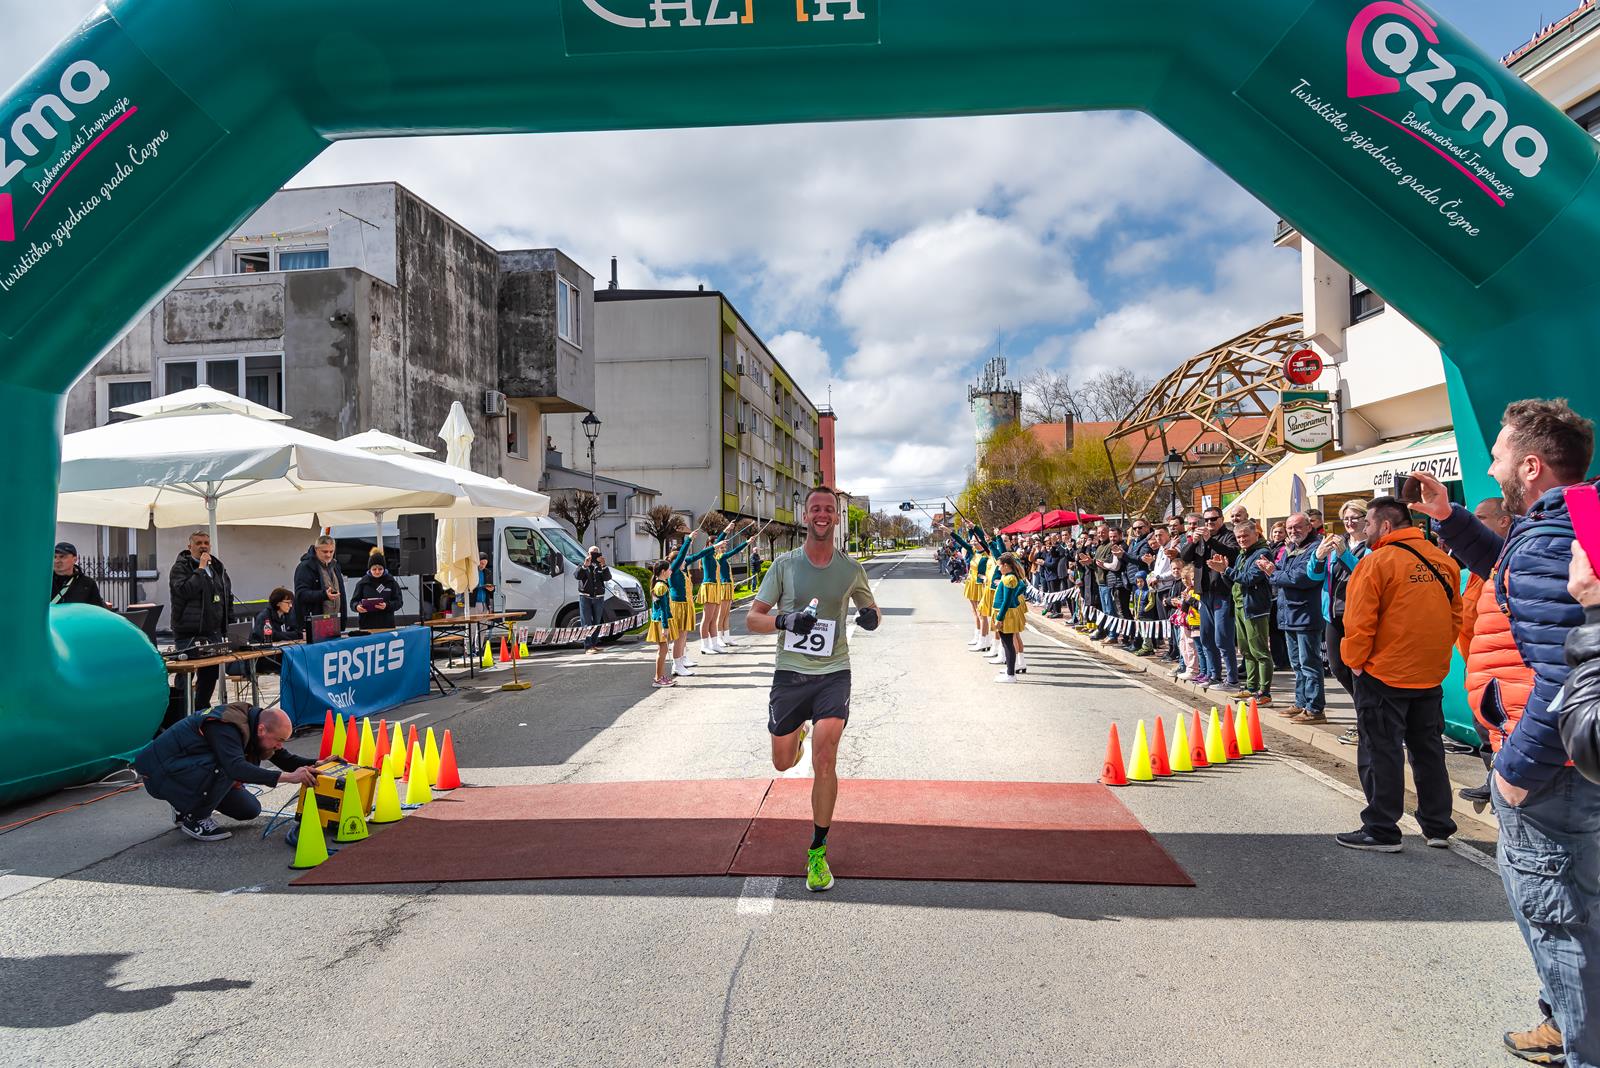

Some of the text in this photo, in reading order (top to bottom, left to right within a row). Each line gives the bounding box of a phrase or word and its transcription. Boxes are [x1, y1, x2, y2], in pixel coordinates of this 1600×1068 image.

[32, 96, 130, 195] Beskonačnost Inspiracije
[51, 194, 101, 246] zajednica
[100, 161, 134, 200] grada
[128, 127, 169, 166] Čazme
[1290, 79, 1480, 237] Turistička zajednica grada Čazme
[1400, 111, 1514, 200] Beskonačnost Inspiracije
[1373, 470, 1393, 486] caffe
[793, 633, 825, 652] 29
[327, 686, 356, 709] Bank
